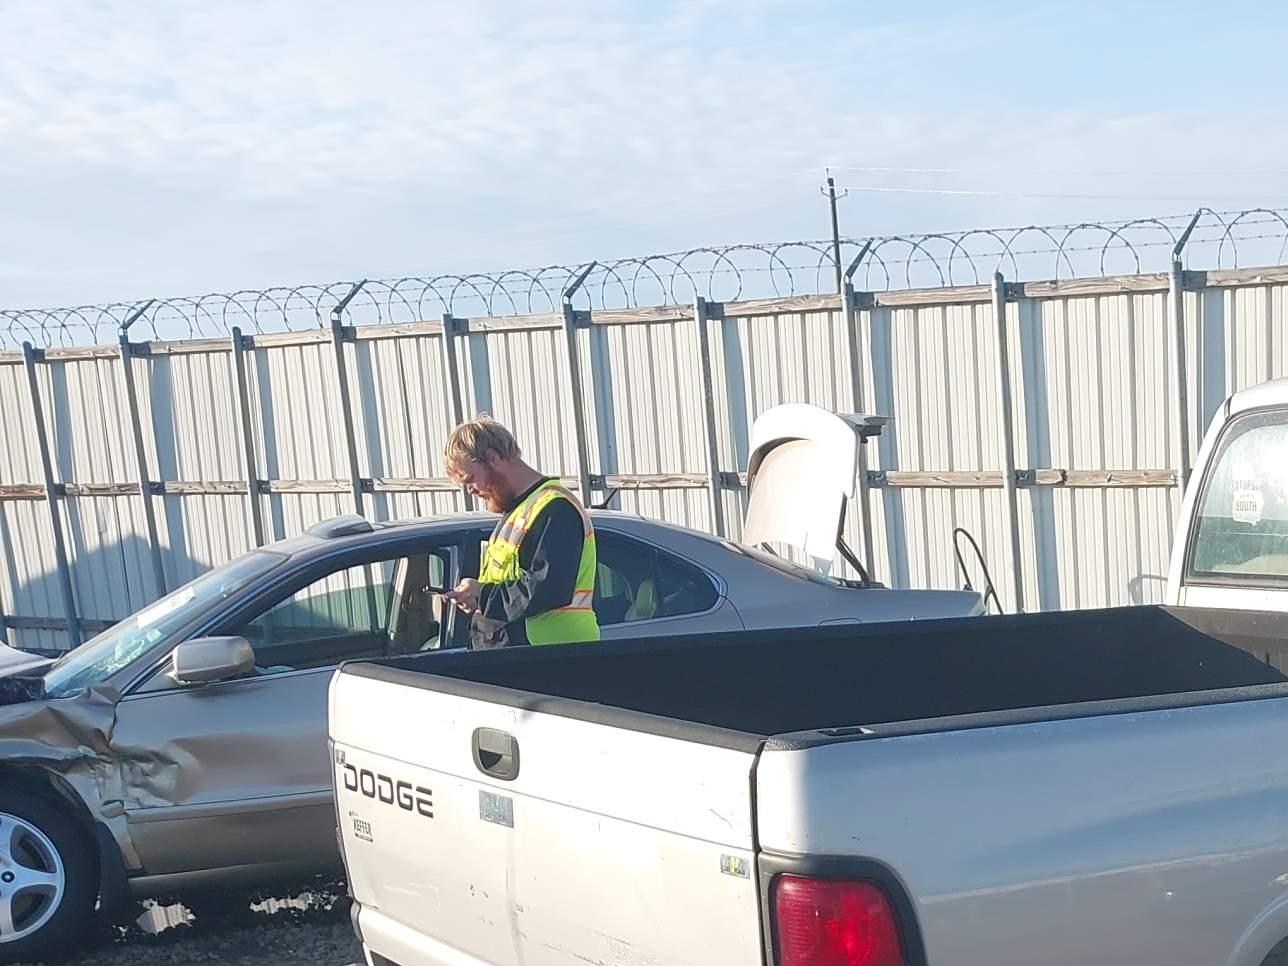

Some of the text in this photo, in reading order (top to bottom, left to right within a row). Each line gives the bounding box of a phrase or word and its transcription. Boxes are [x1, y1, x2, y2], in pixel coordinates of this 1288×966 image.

[1236, 501, 1257, 512] SOUTH
[344, 764, 434, 819] DODGE
[353, 818, 372, 837] KEFFER
